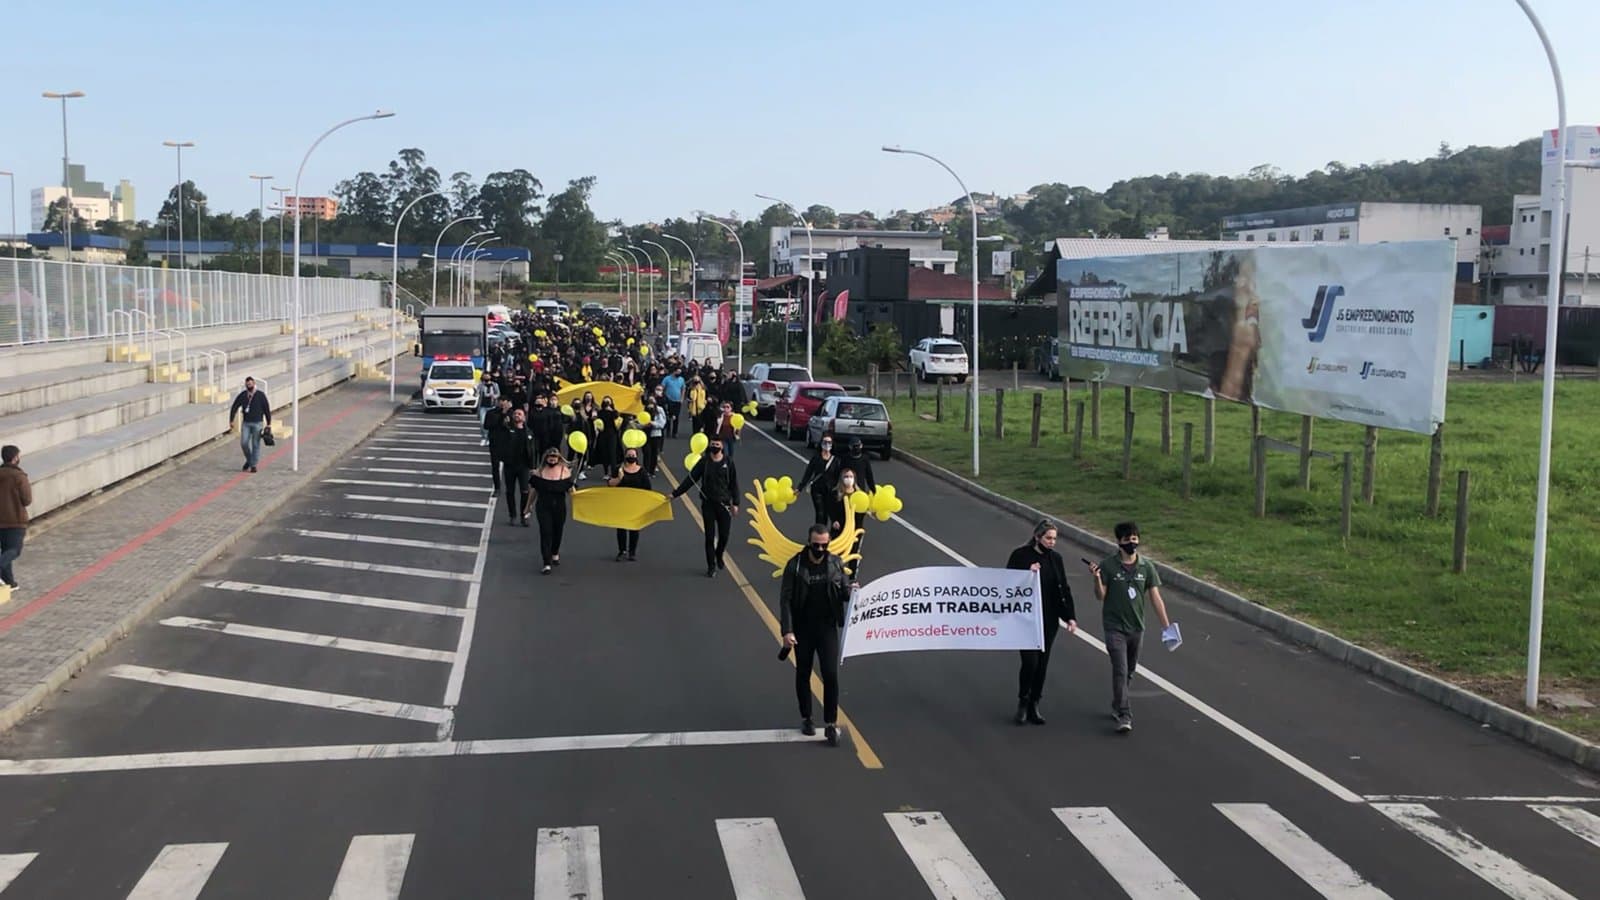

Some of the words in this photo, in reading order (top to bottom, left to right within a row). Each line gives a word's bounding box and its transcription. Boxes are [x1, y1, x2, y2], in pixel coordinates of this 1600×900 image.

[1346, 308, 1415, 324] EMPREENDIMENTOS
[870, 591, 889, 605] SÃO
[891, 589, 901, 600] 15
[903, 586, 930, 599] DIAS
[934, 586, 1002, 600] PARADOS,
[1006, 585, 1033, 599] SÃO
[860, 604, 898, 622] MESES
[902, 602, 932, 615] SEM
[936, 601, 1033, 614] TRABALHAR
[866, 624, 997, 640] #VivemosdeEventos
